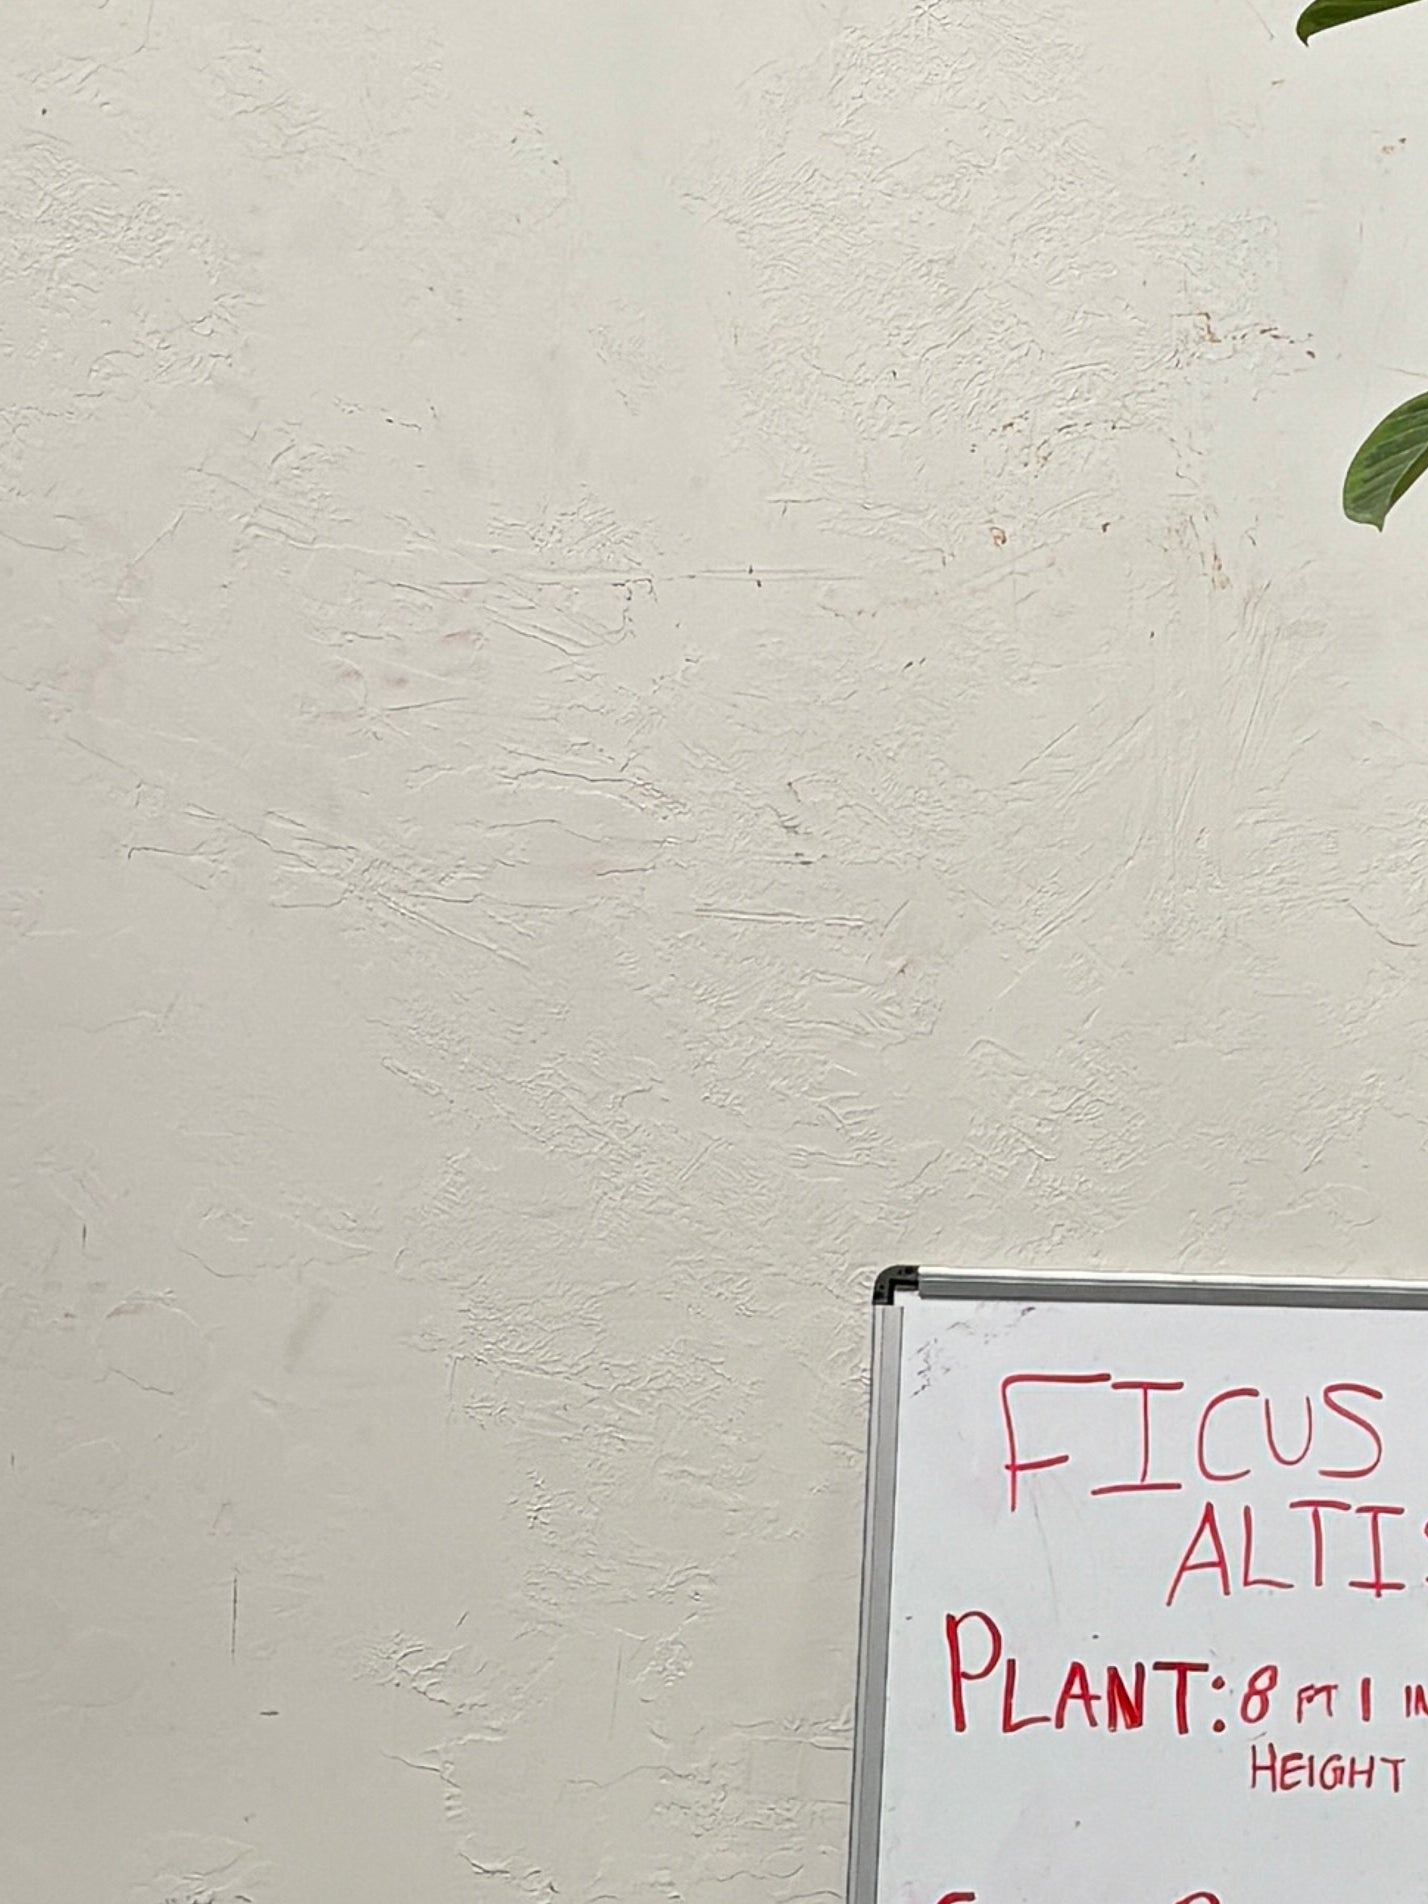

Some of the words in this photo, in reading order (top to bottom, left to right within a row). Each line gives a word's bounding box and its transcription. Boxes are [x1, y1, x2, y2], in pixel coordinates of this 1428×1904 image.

[999, 1373, 1384, 1511] FICUS
[945, 1612, 1226, 1736] PLANT:
[1239, 1664, 1279, 1724] 8
[1296, 1683, 1338, 1724] FT
[1359, 1676, 1373, 1723] 1
[1250, 1743, 1405, 1793] HEIGHT
